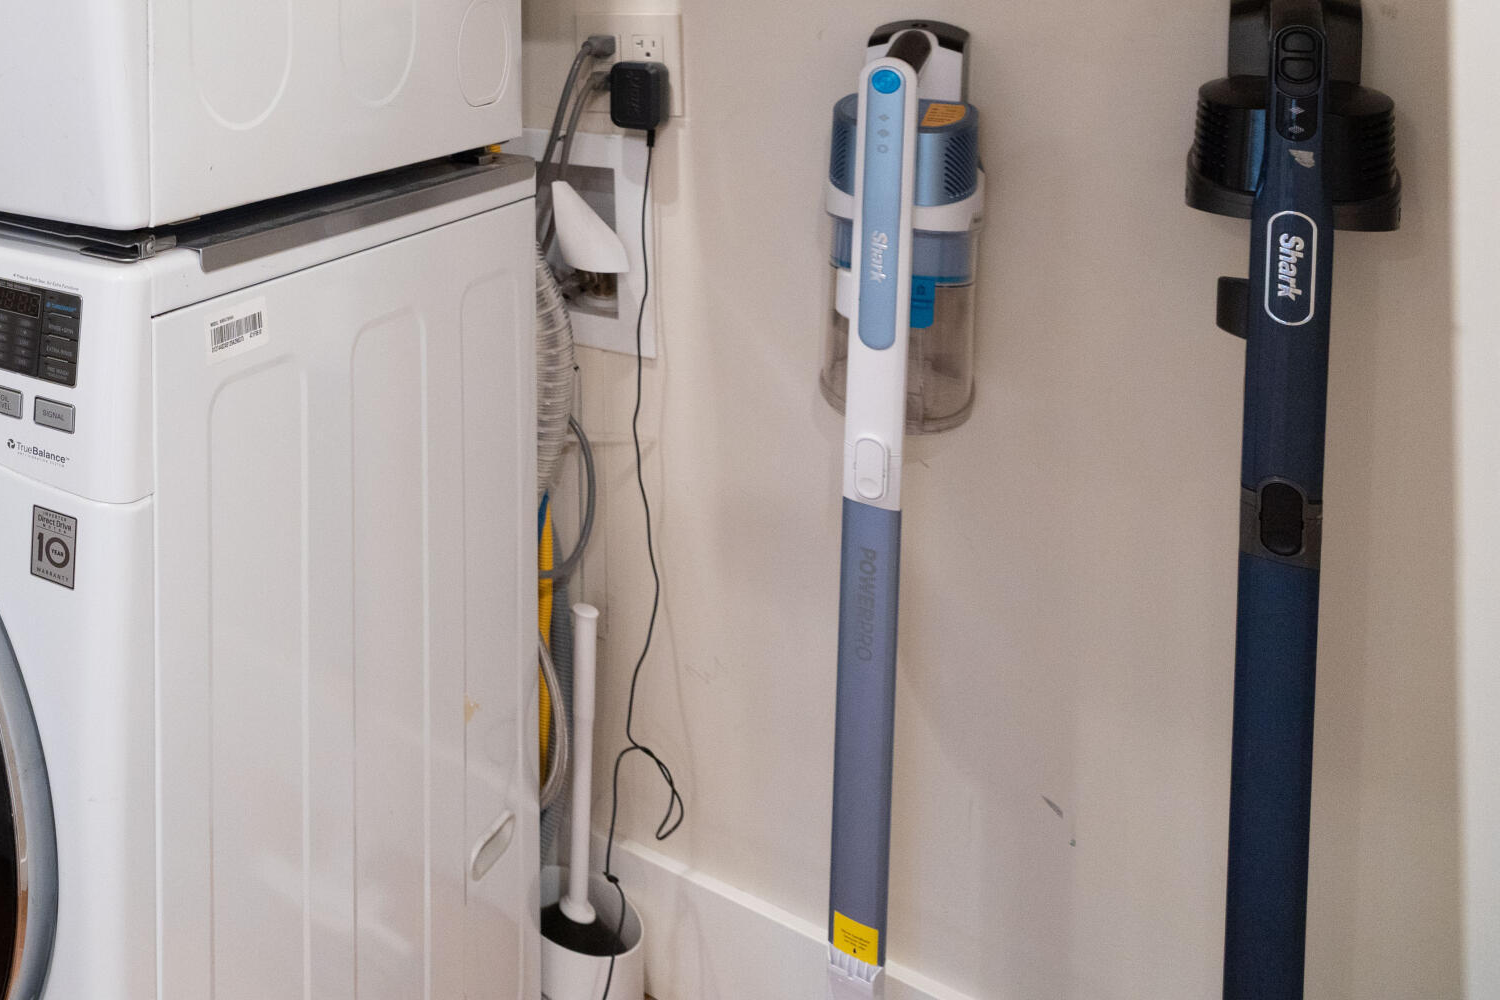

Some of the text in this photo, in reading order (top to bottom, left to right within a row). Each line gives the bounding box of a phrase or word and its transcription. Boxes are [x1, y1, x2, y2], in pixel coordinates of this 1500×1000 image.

[870, 230, 888, 283] Shark
[1277, 233, 1305, 302] Shark
[42, 409, 65, 422] SIGNAL
[37, 514, 72, 532] Direct Drive
[43, 511, 67, 522] INVERTER
[42, 523, 67, 534] MOTOR
[37, 532, 70, 568] 10
[51, 548, 64, 557] YEAR
[36, 566, 69, 582] WARRANTY
[856, 546, 877, 661] POWERPRO
